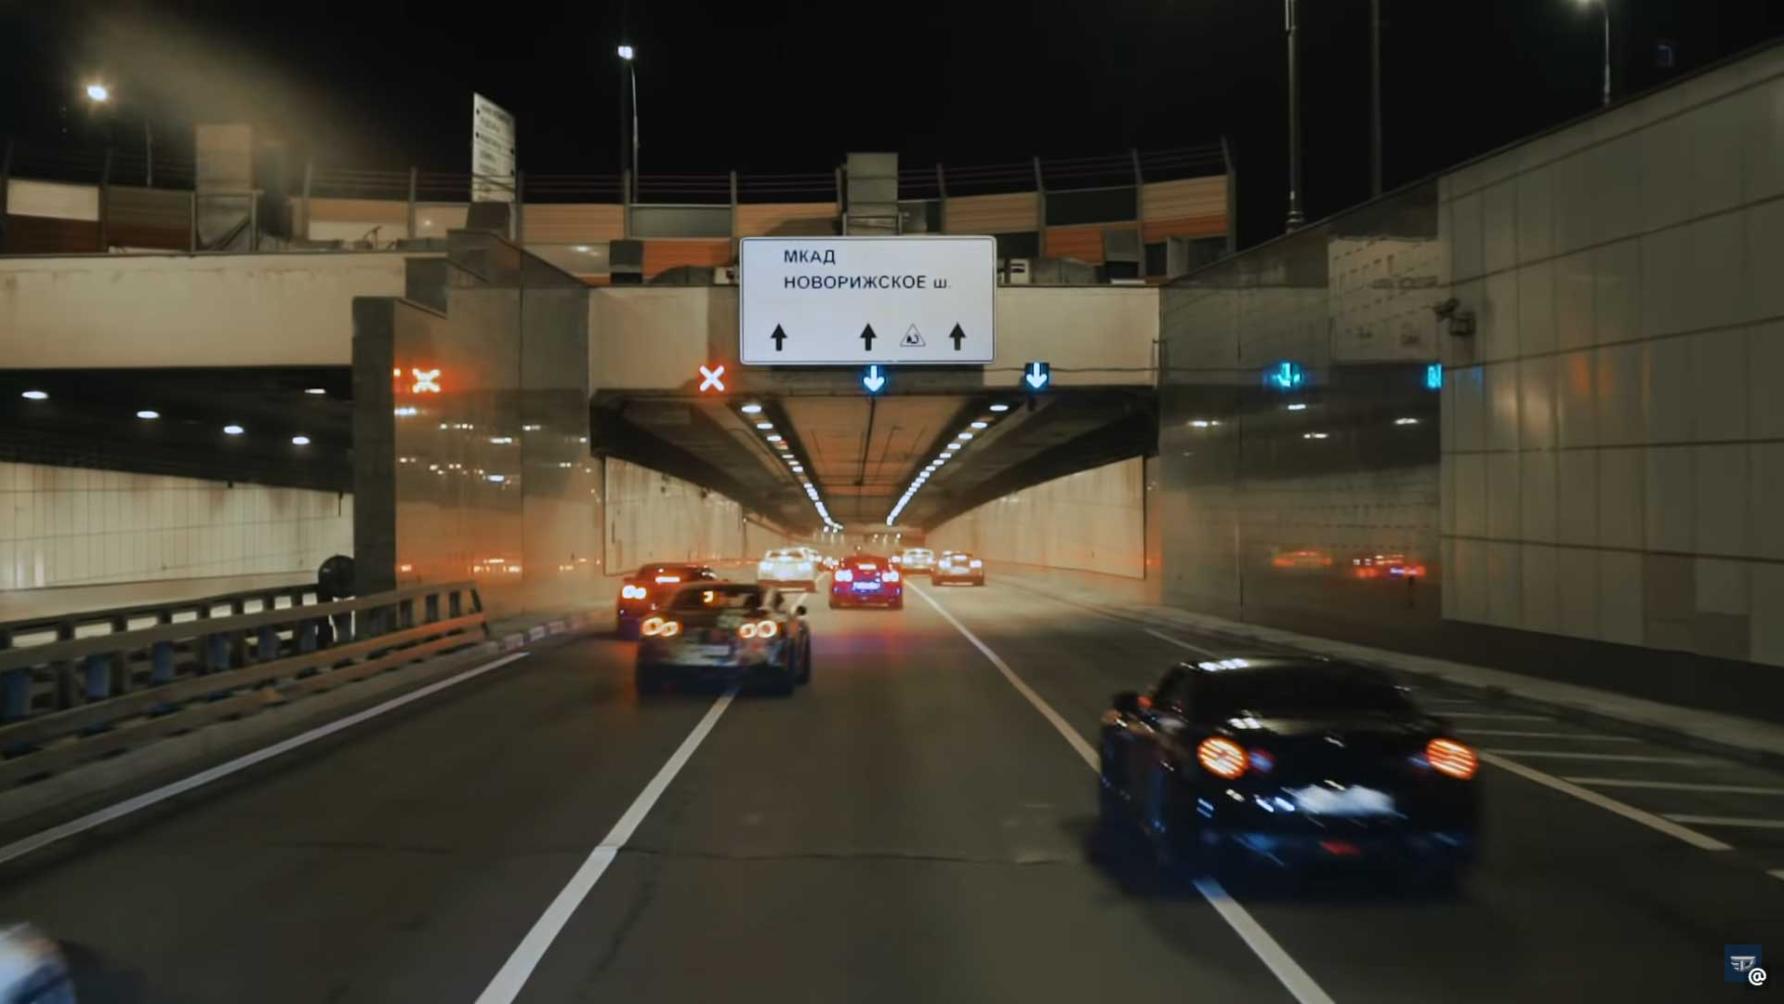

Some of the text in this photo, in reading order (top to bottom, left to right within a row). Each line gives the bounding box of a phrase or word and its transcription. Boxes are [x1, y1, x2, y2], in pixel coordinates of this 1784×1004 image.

[784, 249, 836, 265] МКАД
[784, 275, 951, 289] НОВОРИЖСКОЕ ш.
